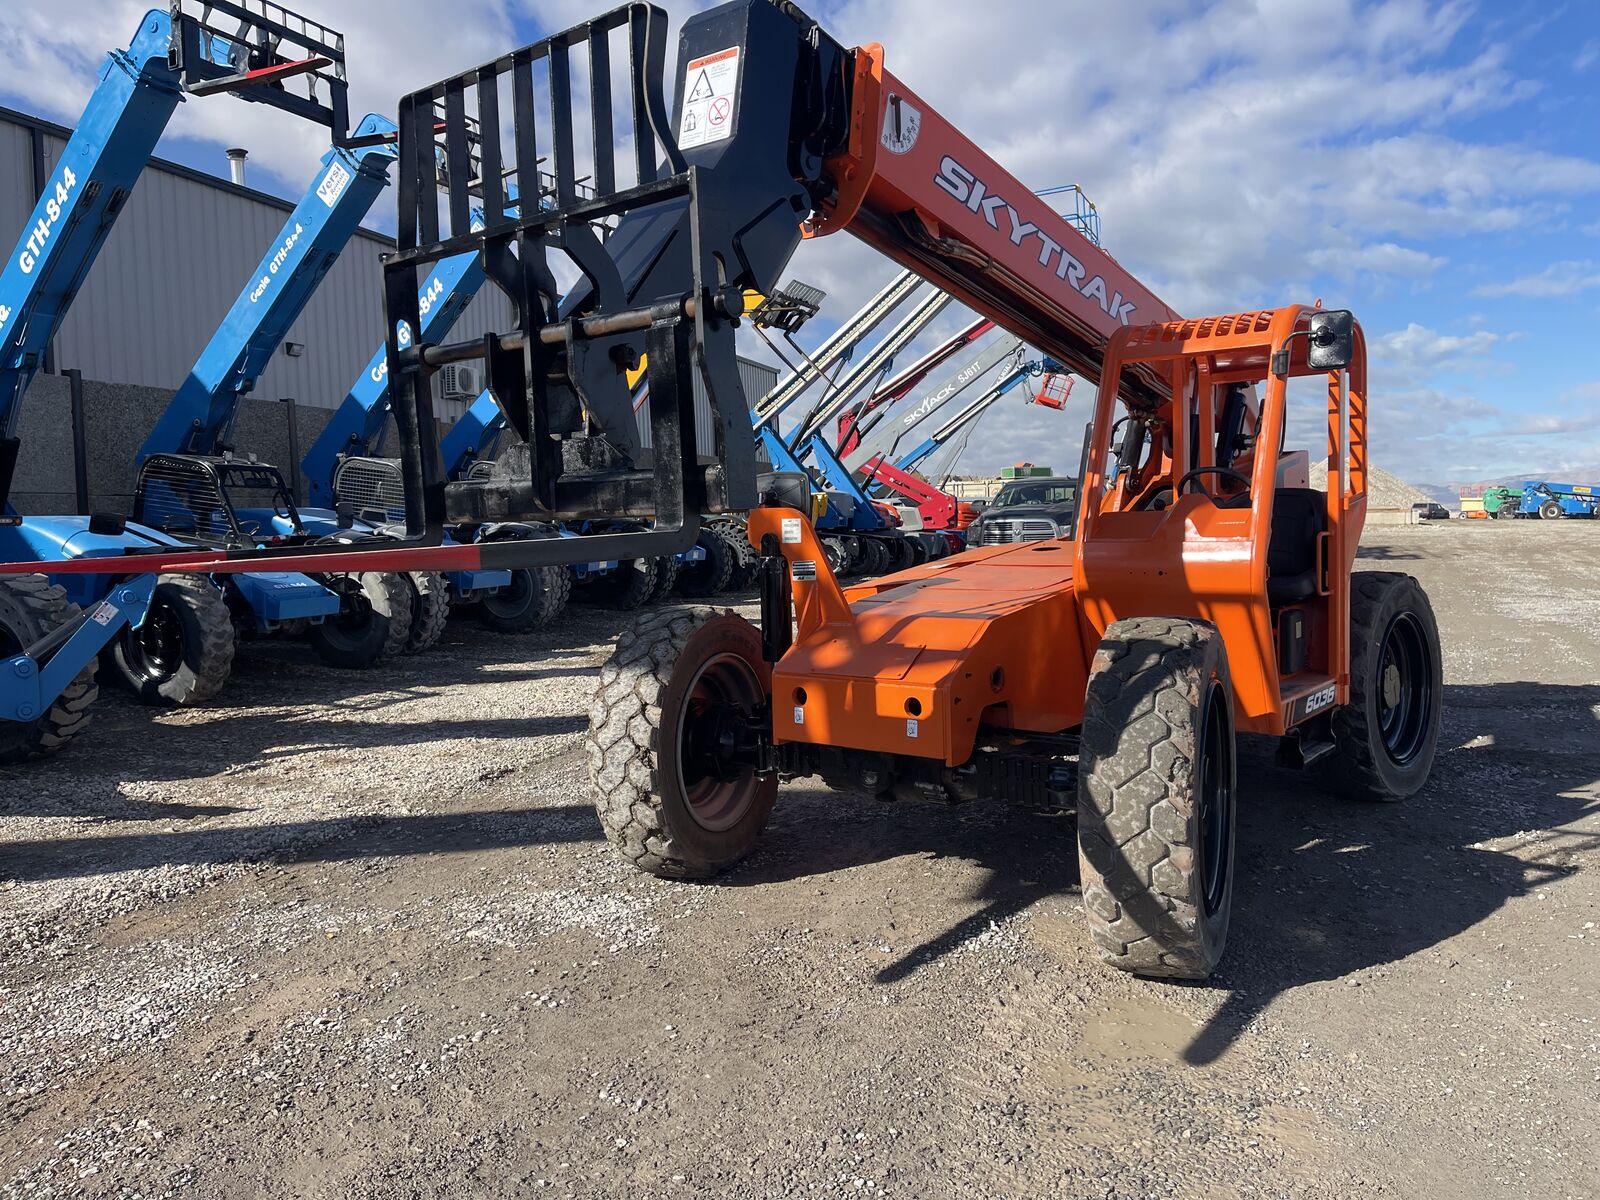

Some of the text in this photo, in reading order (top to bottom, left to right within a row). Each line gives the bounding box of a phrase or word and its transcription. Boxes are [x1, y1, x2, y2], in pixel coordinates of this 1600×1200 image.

[319, 165, 342, 197] Versi
[19, 165, 77, 275] GTH-844
[934, 155, 1137, 327] SKYTRAK
[250, 222, 303, 303] Genie GTH-844
[903, 361, 982, 426] SKYJACK SJ61T
[1305, 685, 1336, 714] 6036
